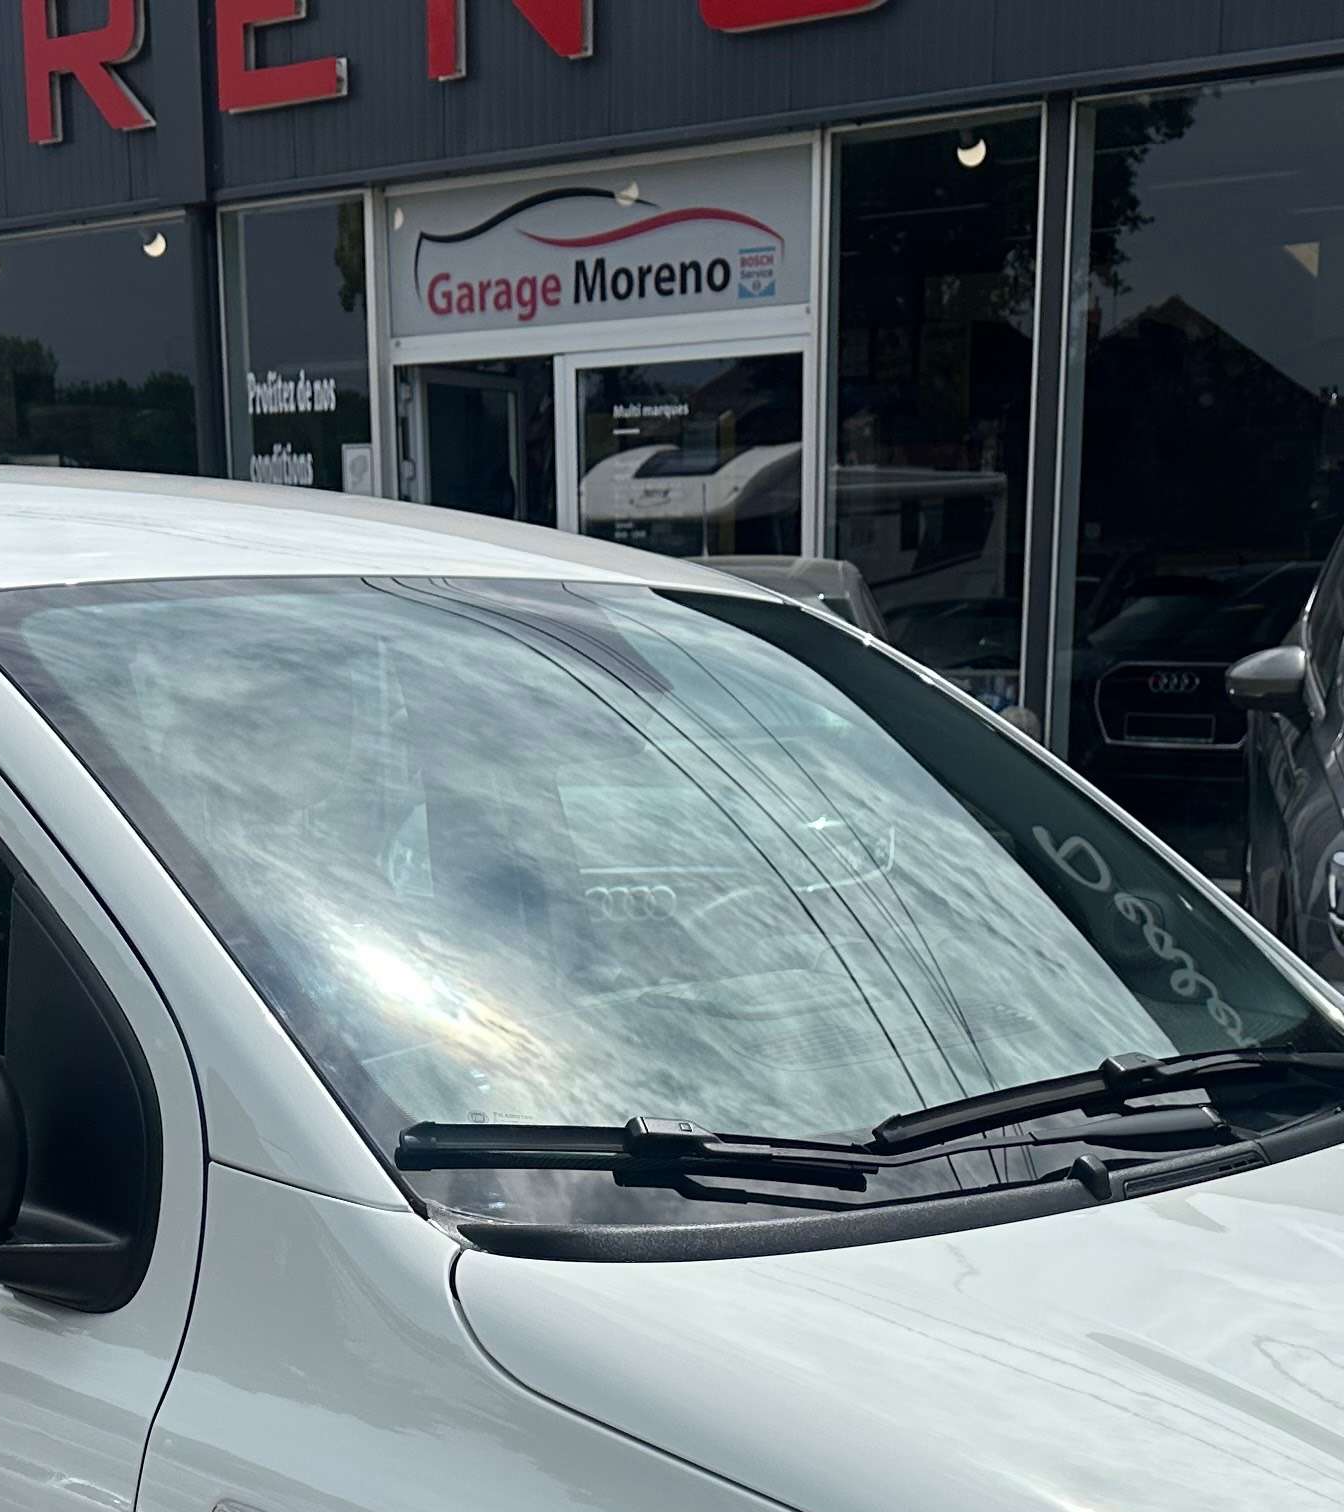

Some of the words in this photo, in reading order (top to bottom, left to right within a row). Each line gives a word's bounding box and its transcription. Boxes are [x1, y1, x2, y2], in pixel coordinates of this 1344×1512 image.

[427, 272, 562, 322] Garage
[573, 257, 731, 305] Moreno
[247, 371, 295, 415] Profitez
[296, 369, 312, 413] de
[313, 378, 336, 413] nos
